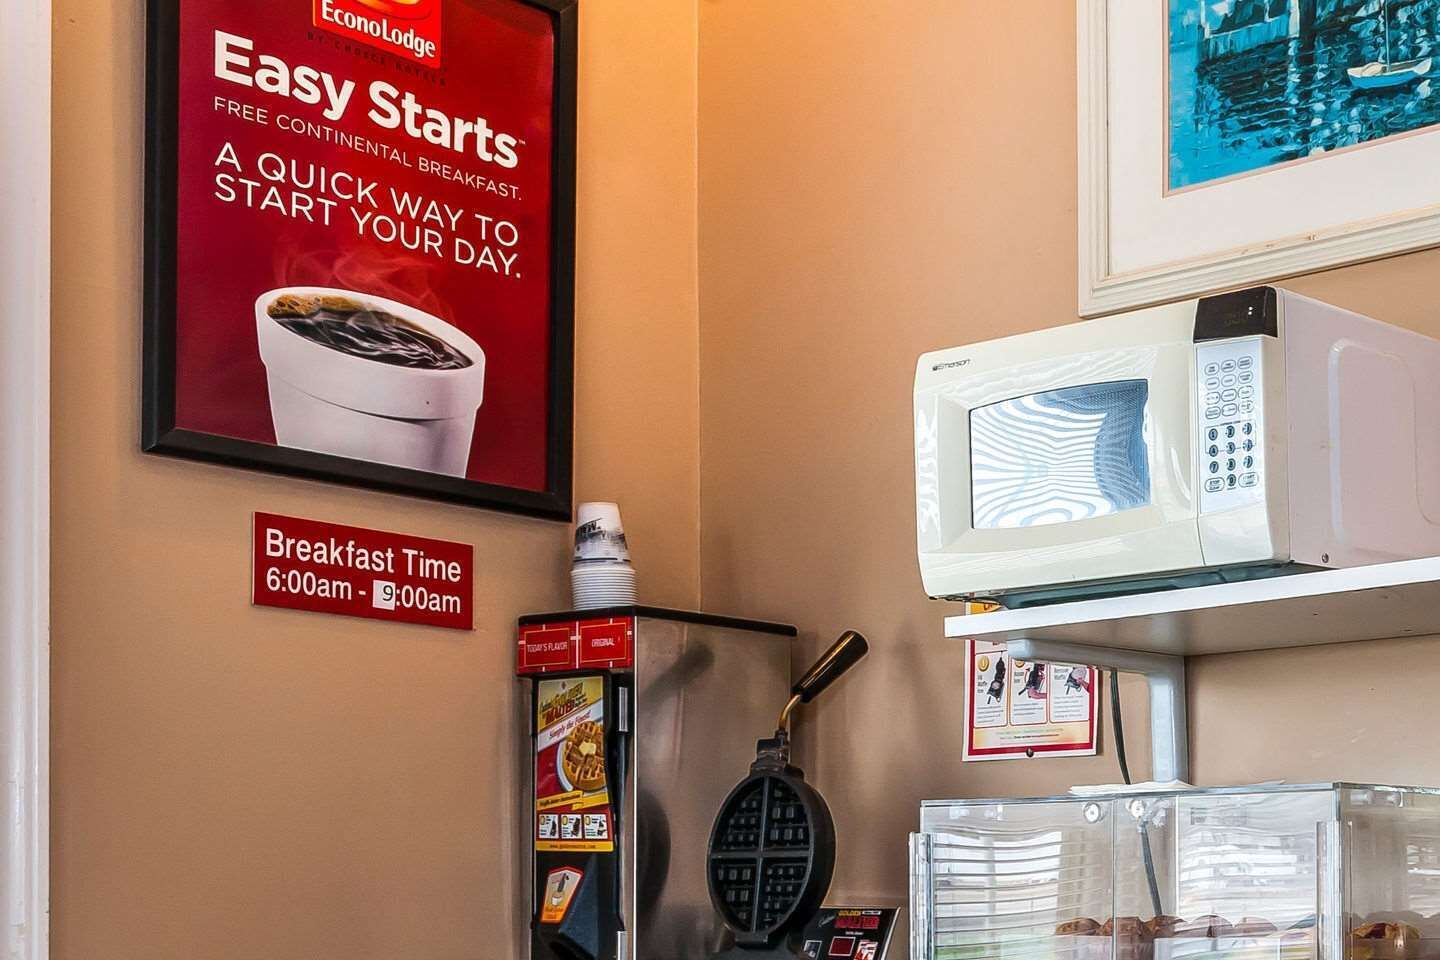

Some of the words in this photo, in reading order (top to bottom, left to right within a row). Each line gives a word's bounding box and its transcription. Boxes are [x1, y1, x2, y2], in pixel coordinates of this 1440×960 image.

[215, 29, 355, 121] Easy
[321, 0, 436, 58] EconoLodge
[214, 96, 268, 124] FREE
[276, 114, 413, 168] CONTINENTAL
[418, 157, 522, 200] BREAKFAST.
[214, 142, 242, 172] A
[257, 152, 378, 208] QUICK
[390, 187, 464, 232] WAY
[474, 213, 519, 247] TO
[214, 174, 337, 225] START
[350, 206, 443, 257] YOUR
[454, 237, 521, 278] DAY.
[265, 528, 395, 573] Breakfast
[402, 548, 462, 582] Time
[266, 567, 352, 600] 6:00am
[382, 584, 461, 614] 9:00am
